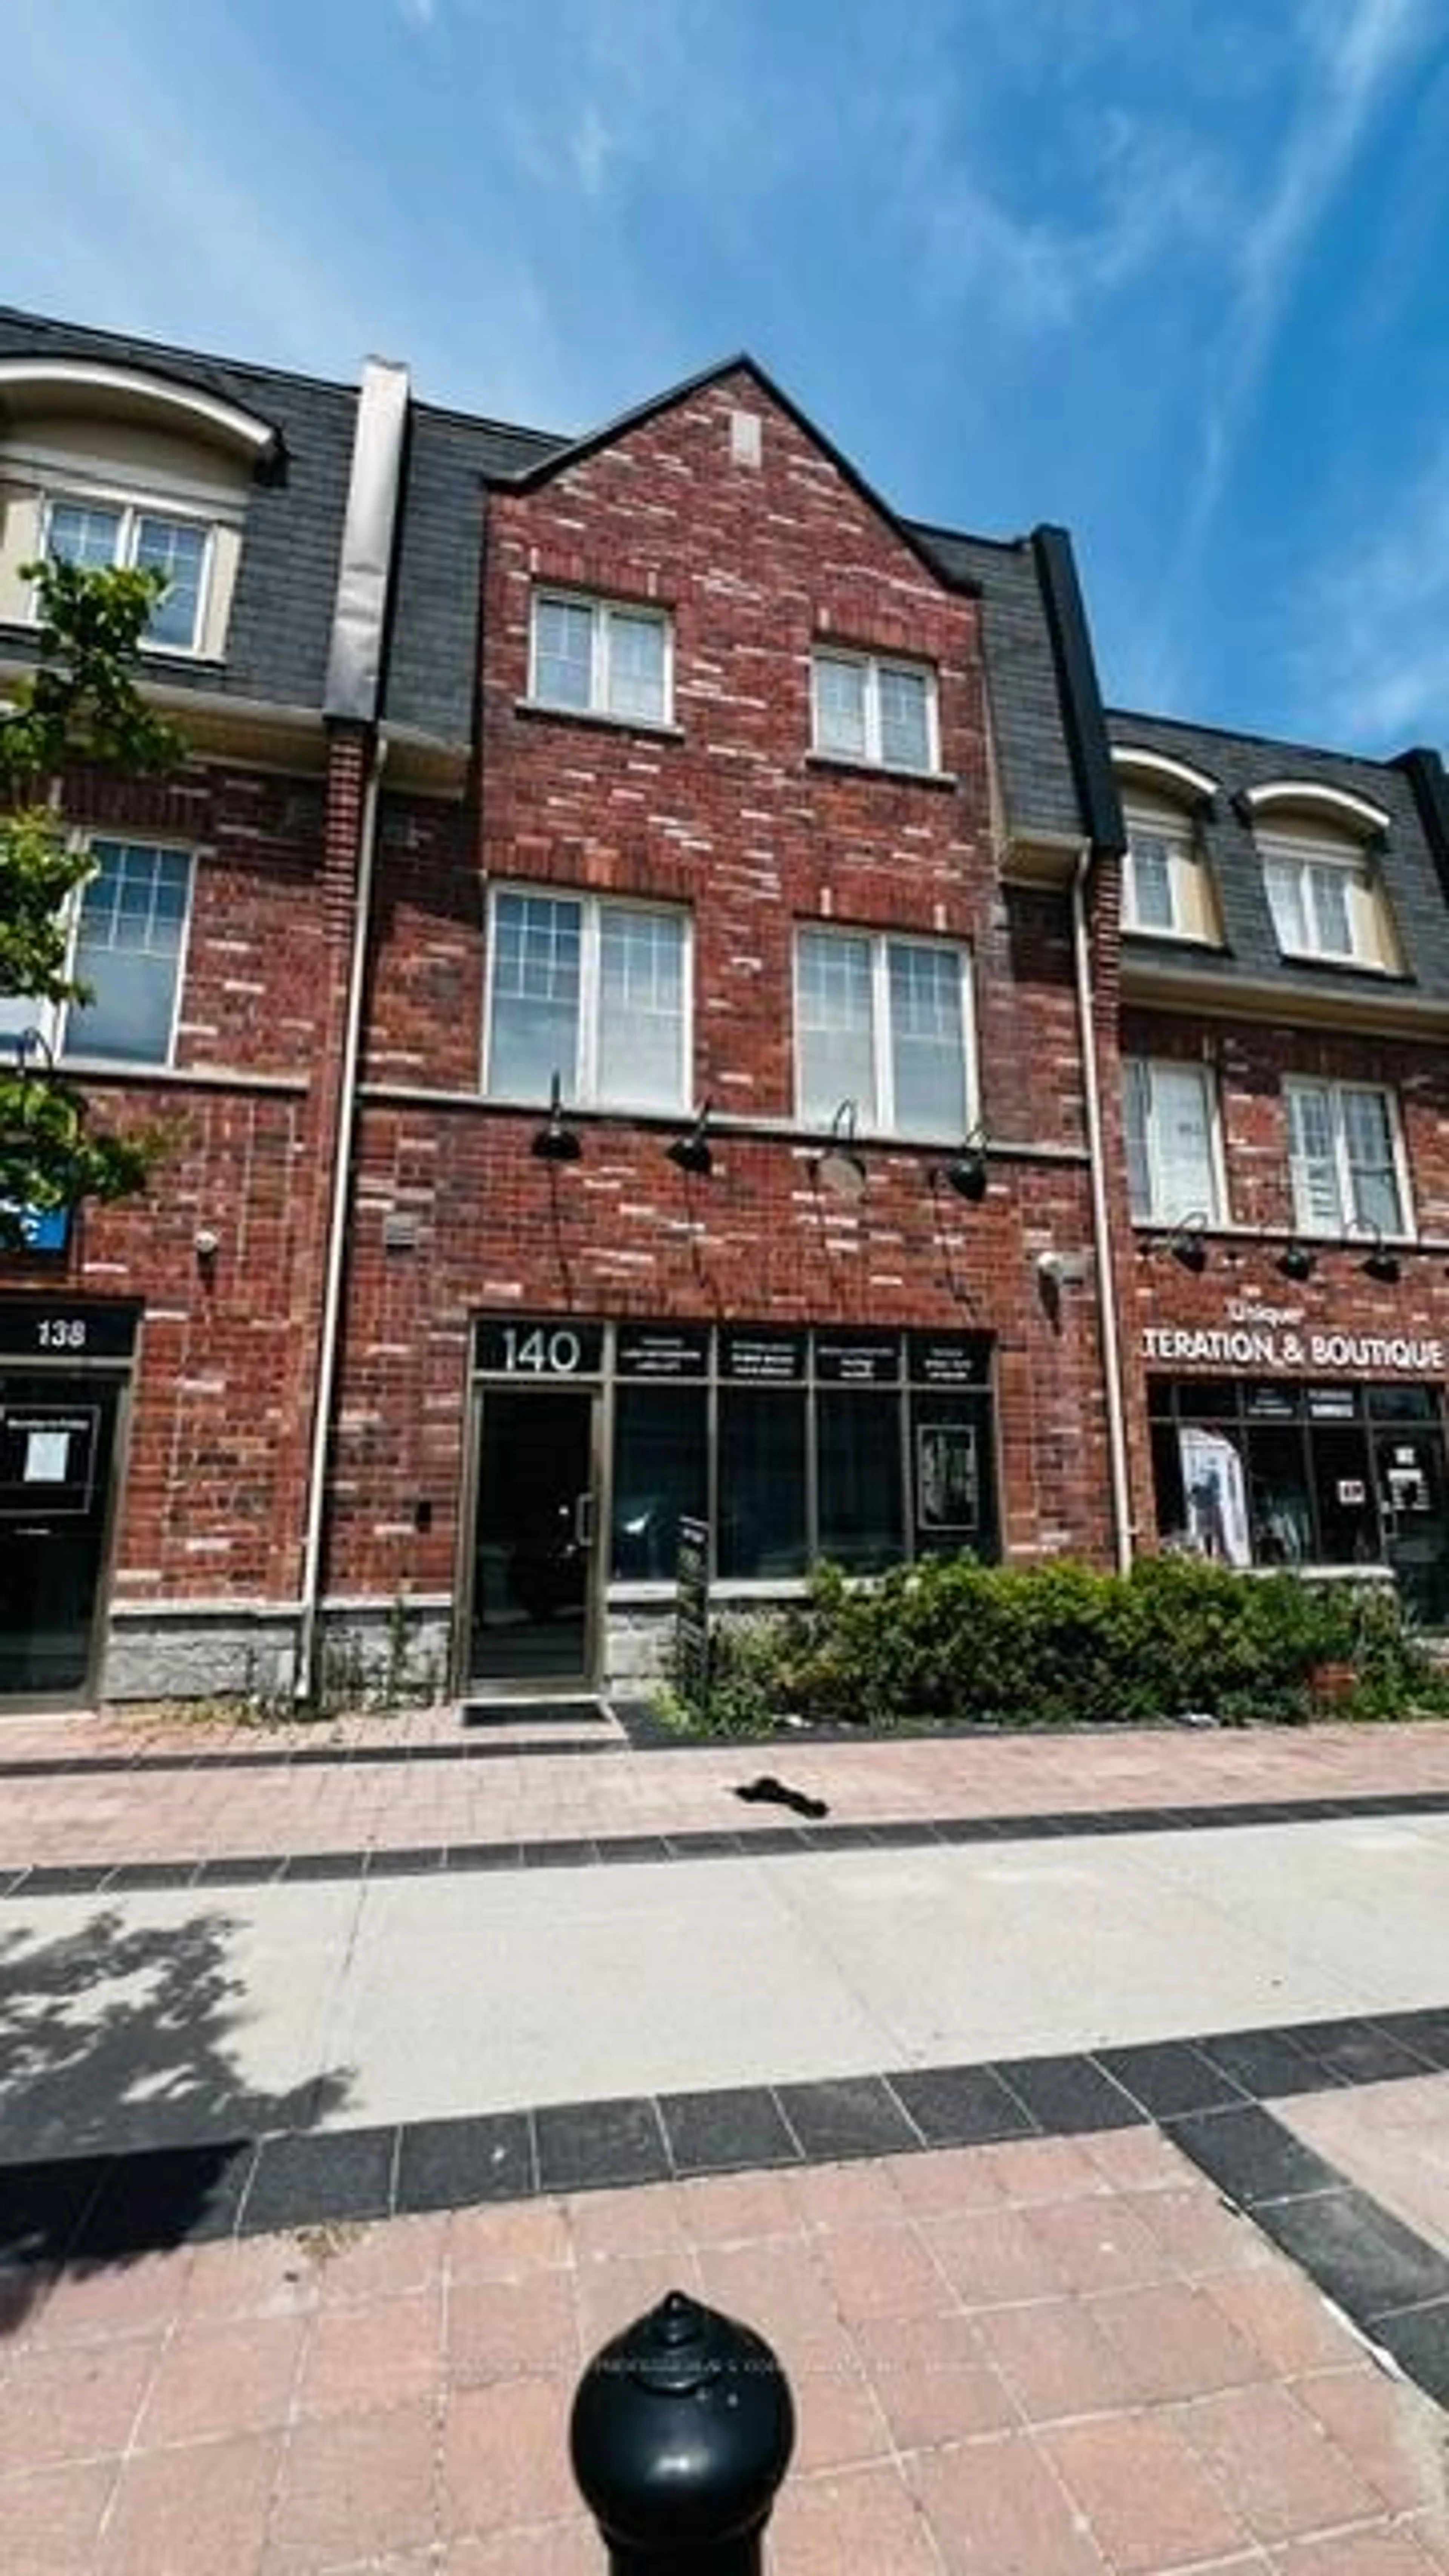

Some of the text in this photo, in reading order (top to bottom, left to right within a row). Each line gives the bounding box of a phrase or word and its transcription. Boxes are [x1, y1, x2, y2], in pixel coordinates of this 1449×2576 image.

[37, 1319, 86, 1346] 138
[503, 1329, 580, 1372] 140
[1141, 1328, 1445, 1367] TERATION & BOUTIQUE
